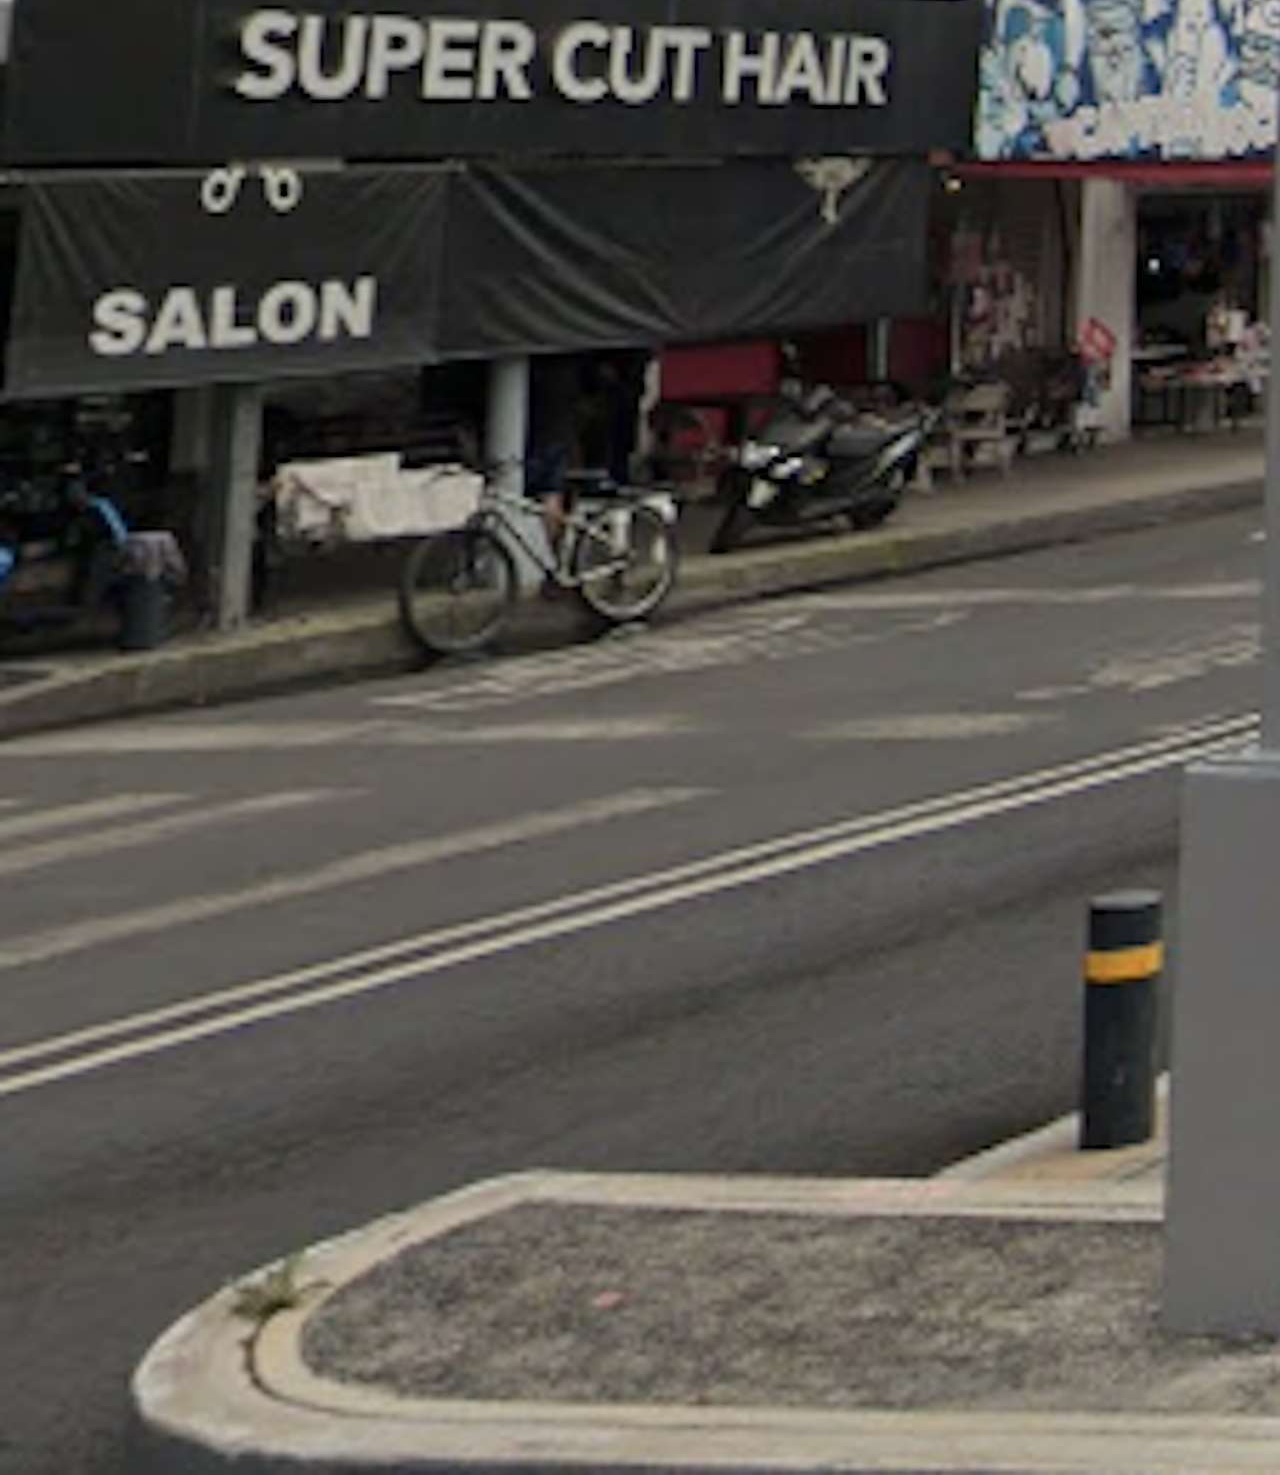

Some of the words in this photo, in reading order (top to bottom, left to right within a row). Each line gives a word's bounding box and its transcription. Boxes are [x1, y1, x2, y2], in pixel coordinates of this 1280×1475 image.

[235, 9, 536, 100] SUPER
[553, 21, 711, 102] CUT
[723, 31, 889, 106] HAIR
[88, 276, 377, 355] SALON
